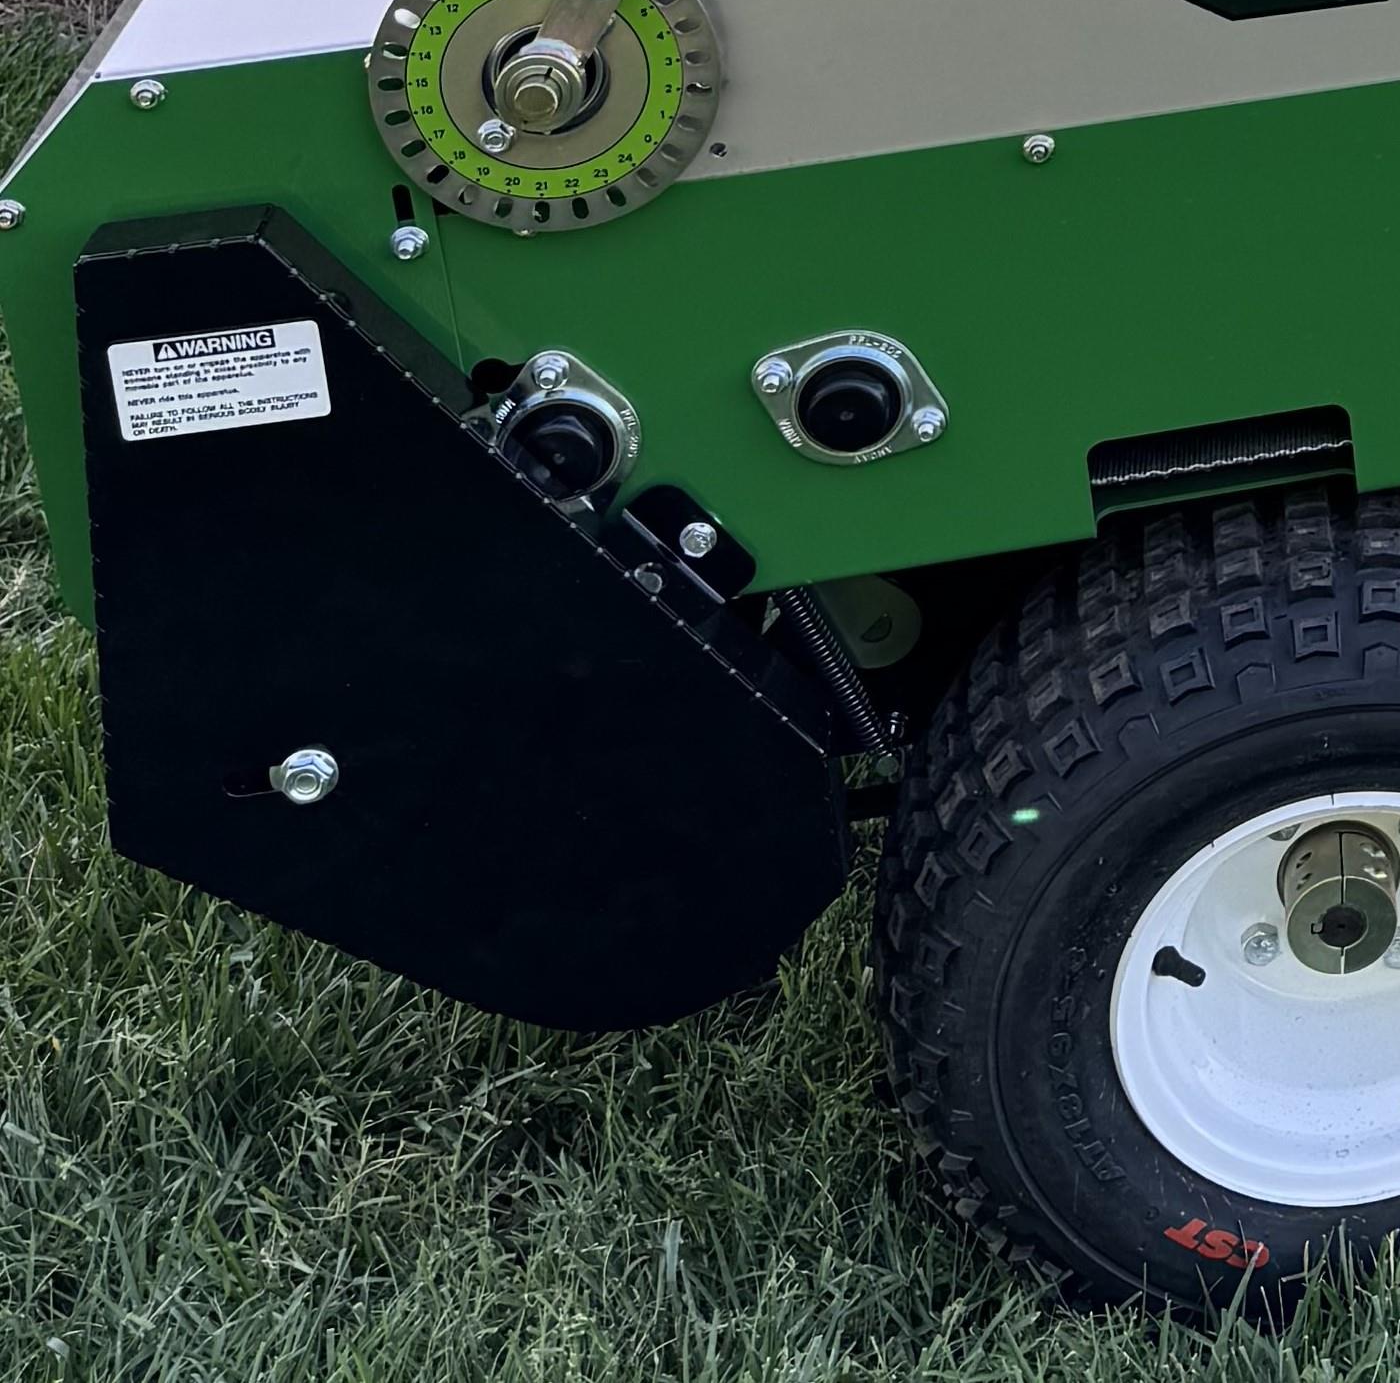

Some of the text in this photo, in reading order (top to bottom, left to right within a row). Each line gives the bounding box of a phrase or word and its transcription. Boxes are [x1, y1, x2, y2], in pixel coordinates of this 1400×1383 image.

[446, 3, 459, 13] 12
[429, 25, 442, 36] 13
[656, 31, 665, 41] 4
[418, 51, 432, 61] 14
[665, 57, 673, 66] 3
[665, 84, 673, 93] 2
[433, 129, 446, 139] 17
[643, 133, 653, 144] 0
[617, 153, 633, 164] 24
[593, 168, 609, 179] 23
[504, 176, 521, 187] 20
[535, 181, 548, 192] 21
[564, 178, 580, 189] 22
[175, 330, 272, 357] WARNING
[1163, 1217, 1270, 1269] CST
